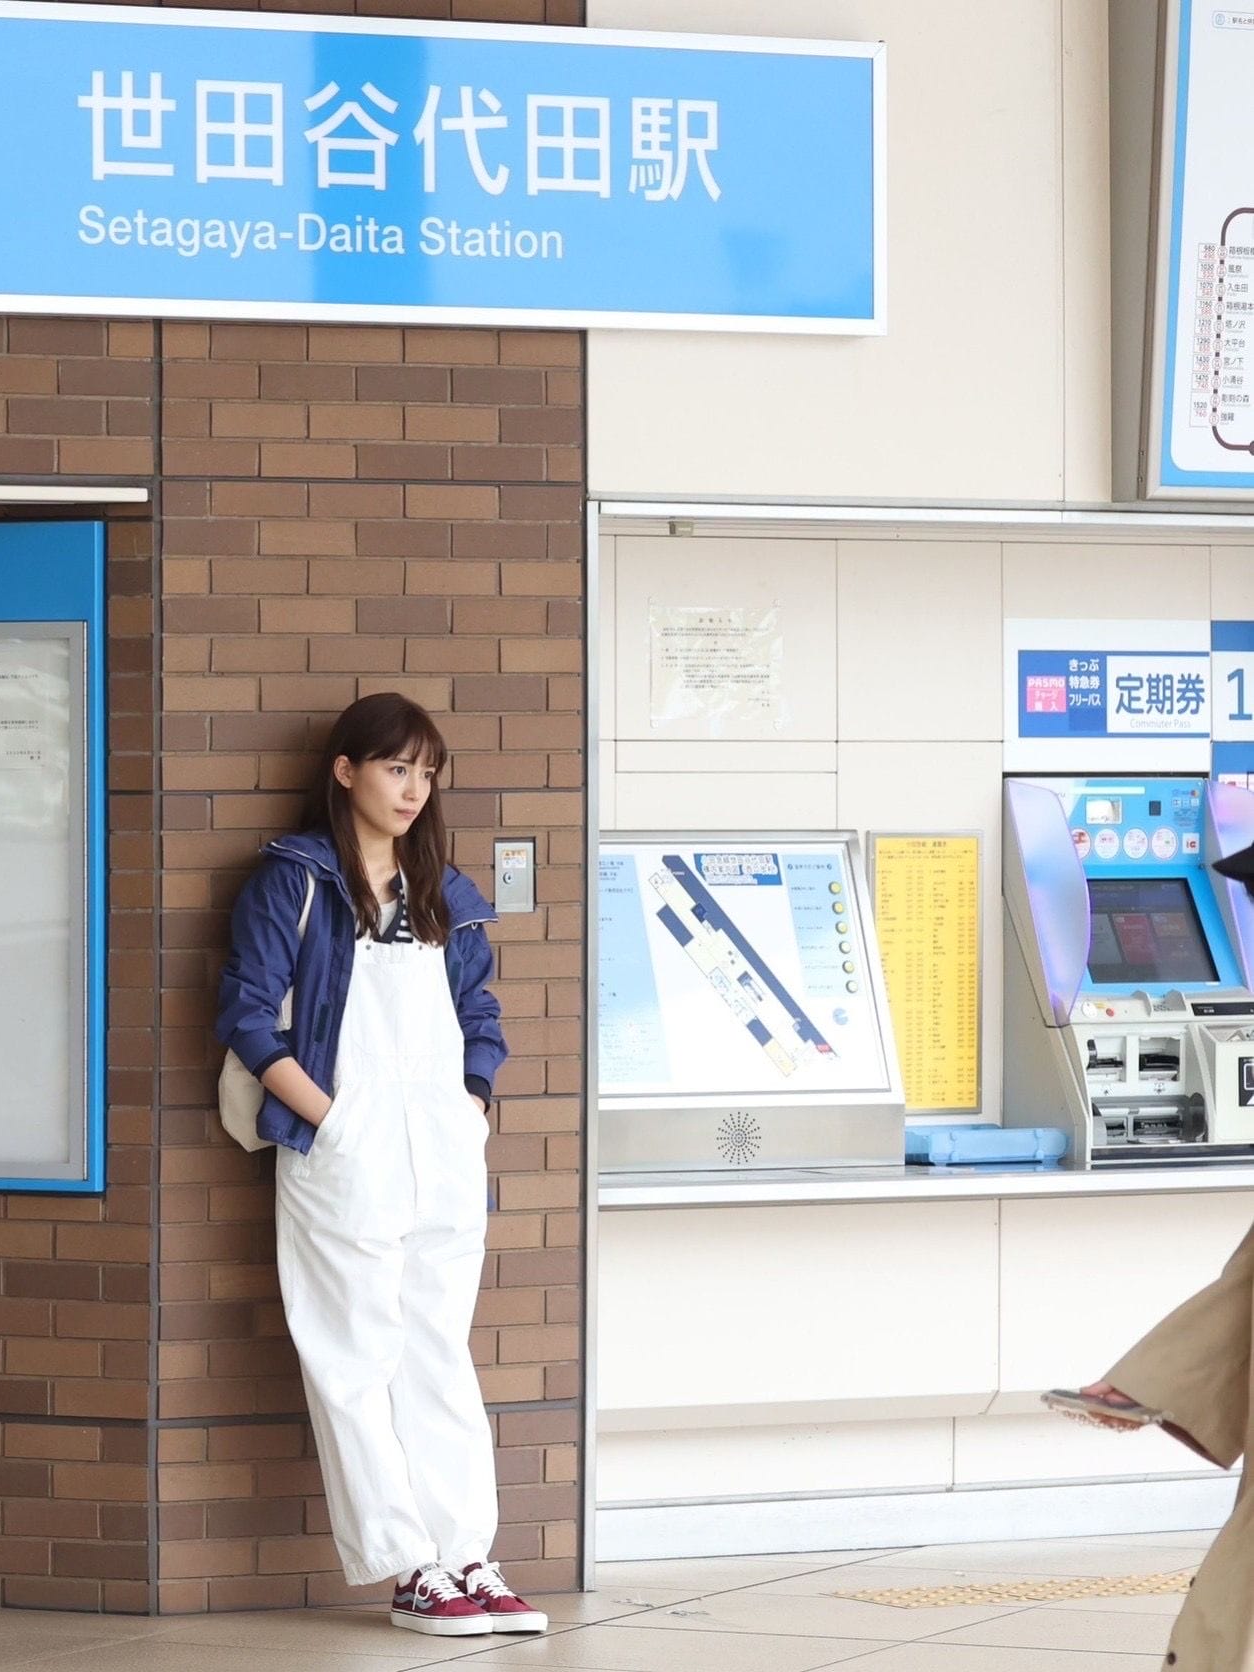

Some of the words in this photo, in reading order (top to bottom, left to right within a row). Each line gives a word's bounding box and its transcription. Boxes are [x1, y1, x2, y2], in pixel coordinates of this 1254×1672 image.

[77, 69, 722, 203] 世田谷代田駅
[77, 204, 405, 259] Setagaya-Daita
[419, 216, 564, 261] Station
[1068, 658, 1100, 672] きっぷ
[1027, 677, 1065, 688] PASMO
[1068, 675, 1100, 689] 特急券
[1068, 693, 1101, 706] フリーパス
[1115, 673, 1205, 715] 定期券
[1227, 668, 1253, 720] 1
[1129, 718, 1171, 728] Commuter
[1173, 719, 1191, 728] Pass
